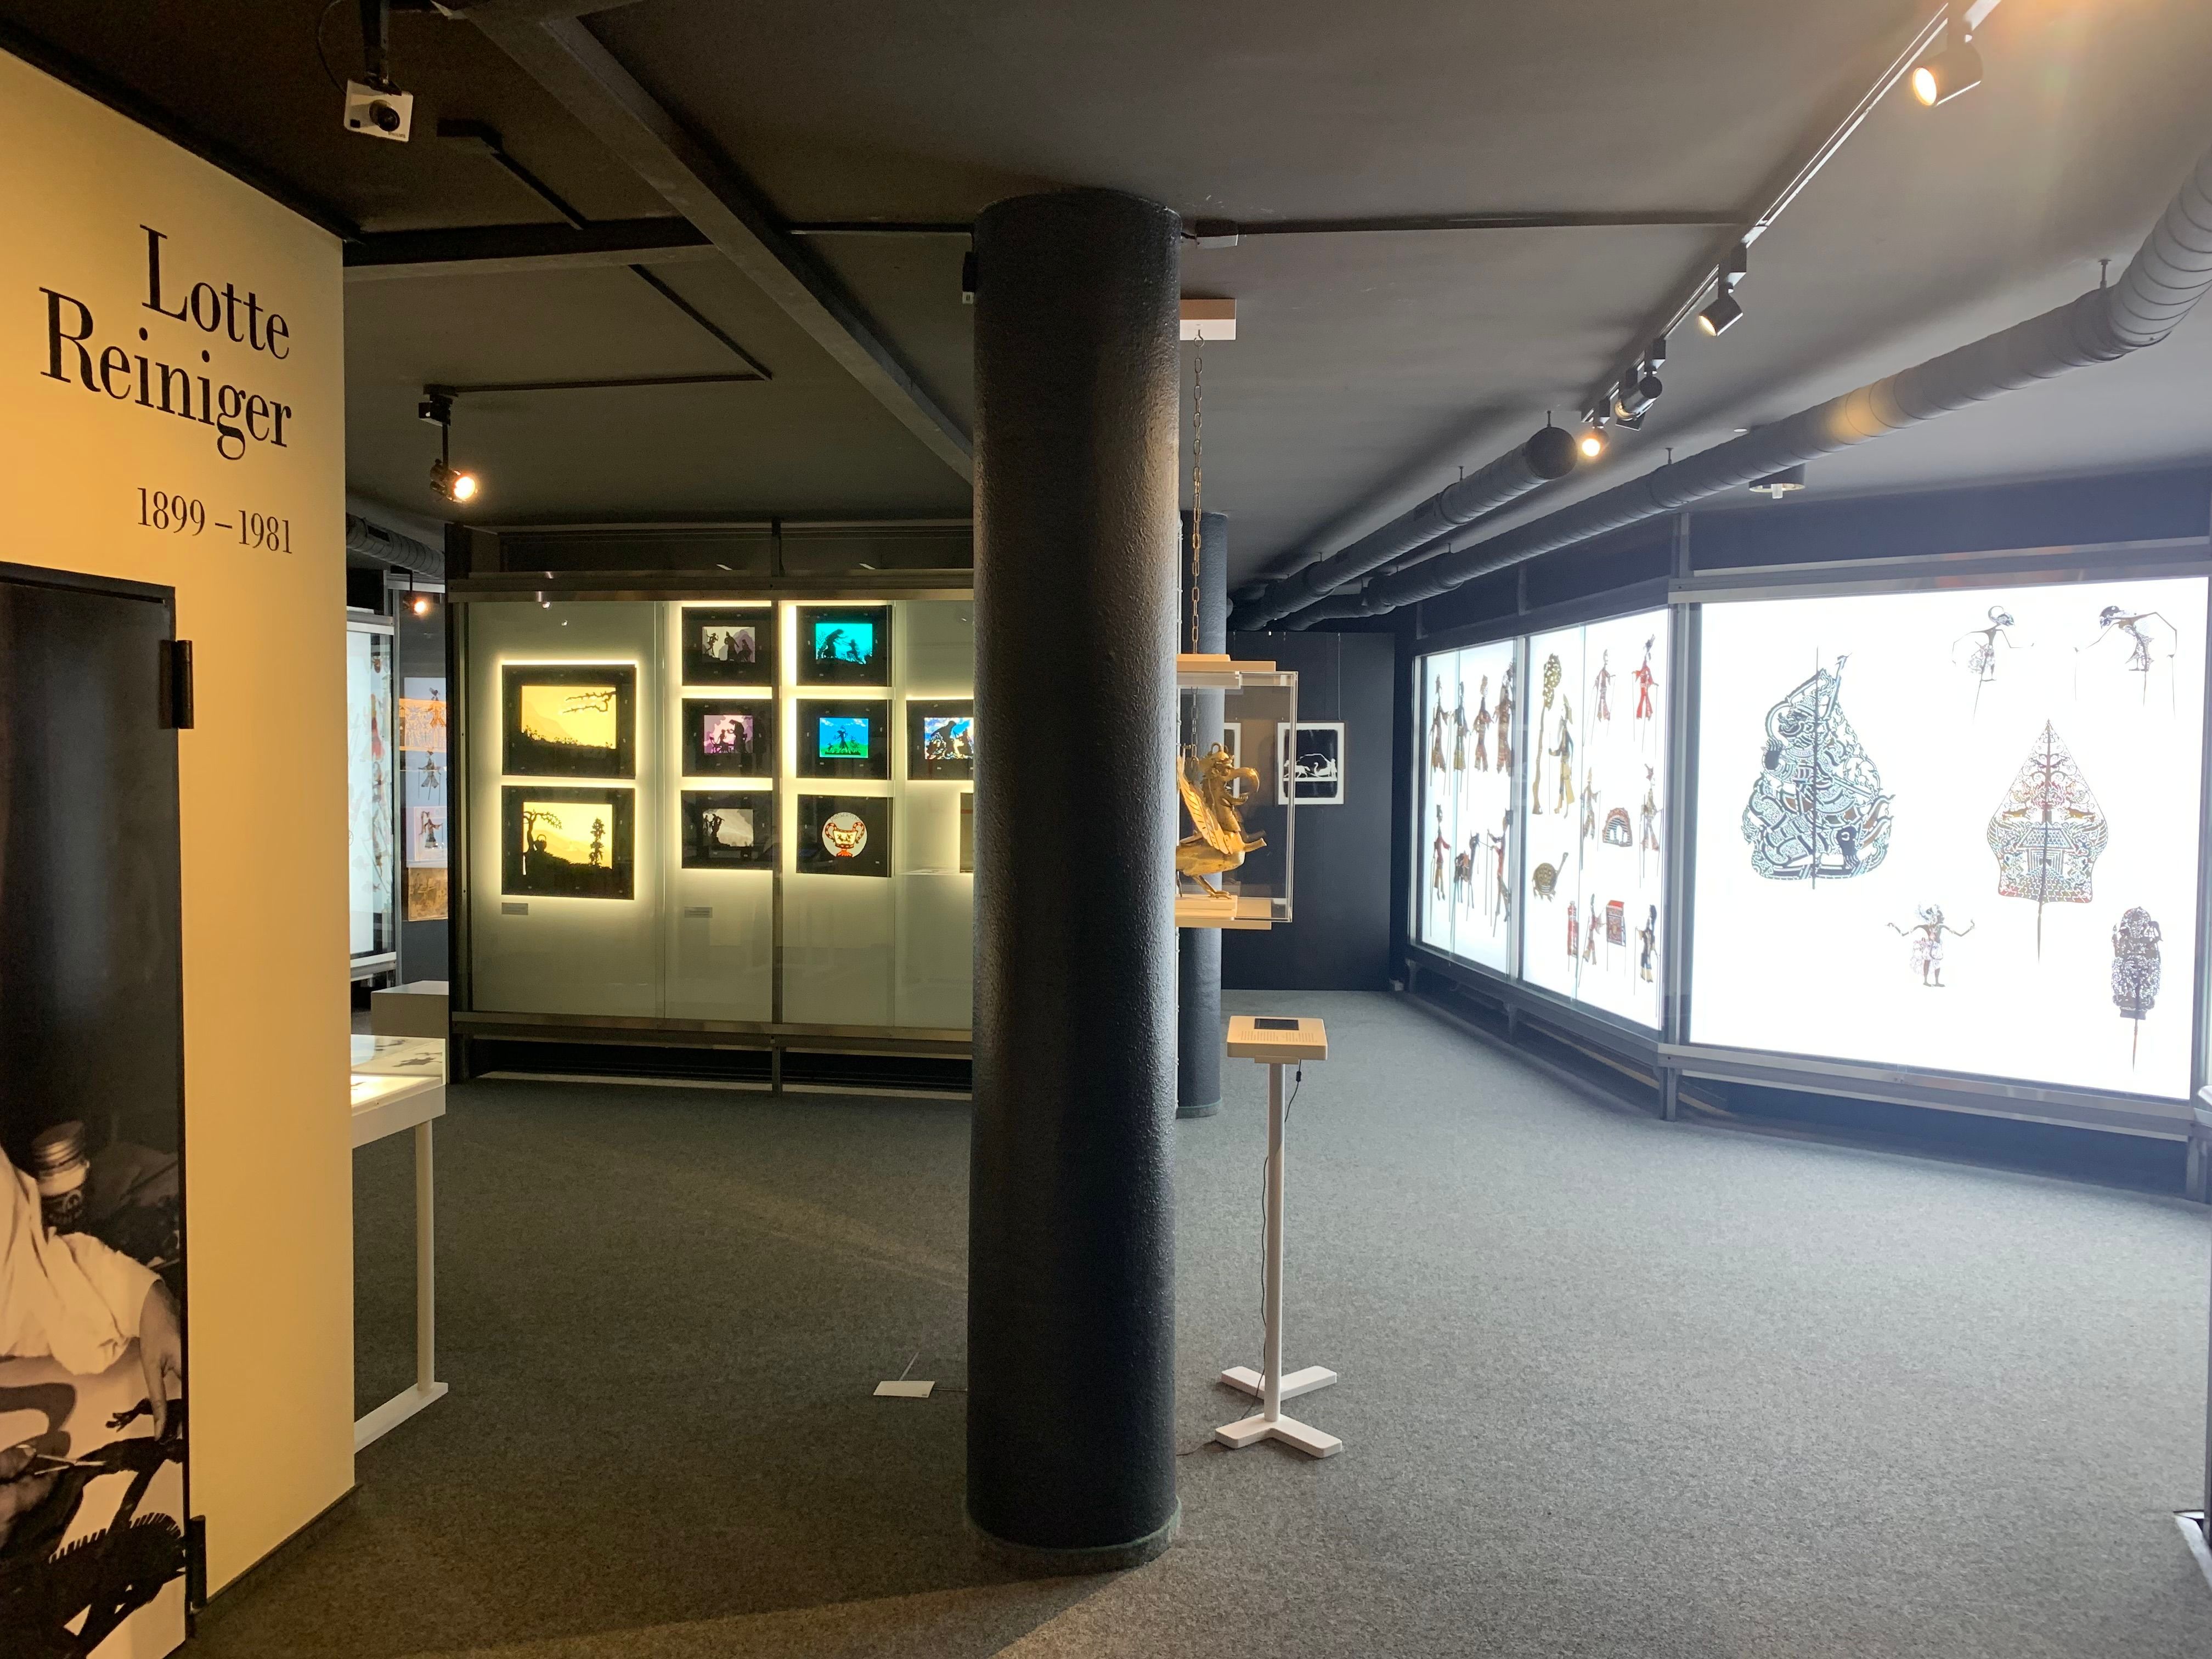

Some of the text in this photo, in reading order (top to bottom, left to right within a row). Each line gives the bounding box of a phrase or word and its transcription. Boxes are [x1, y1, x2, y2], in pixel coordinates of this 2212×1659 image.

[139, 224, 290, 360] Lotte
[39, 286, 292, 460] Reiniger
[137, 487, 206, 537] 1899
[238, 510, 292, 554] 1981
